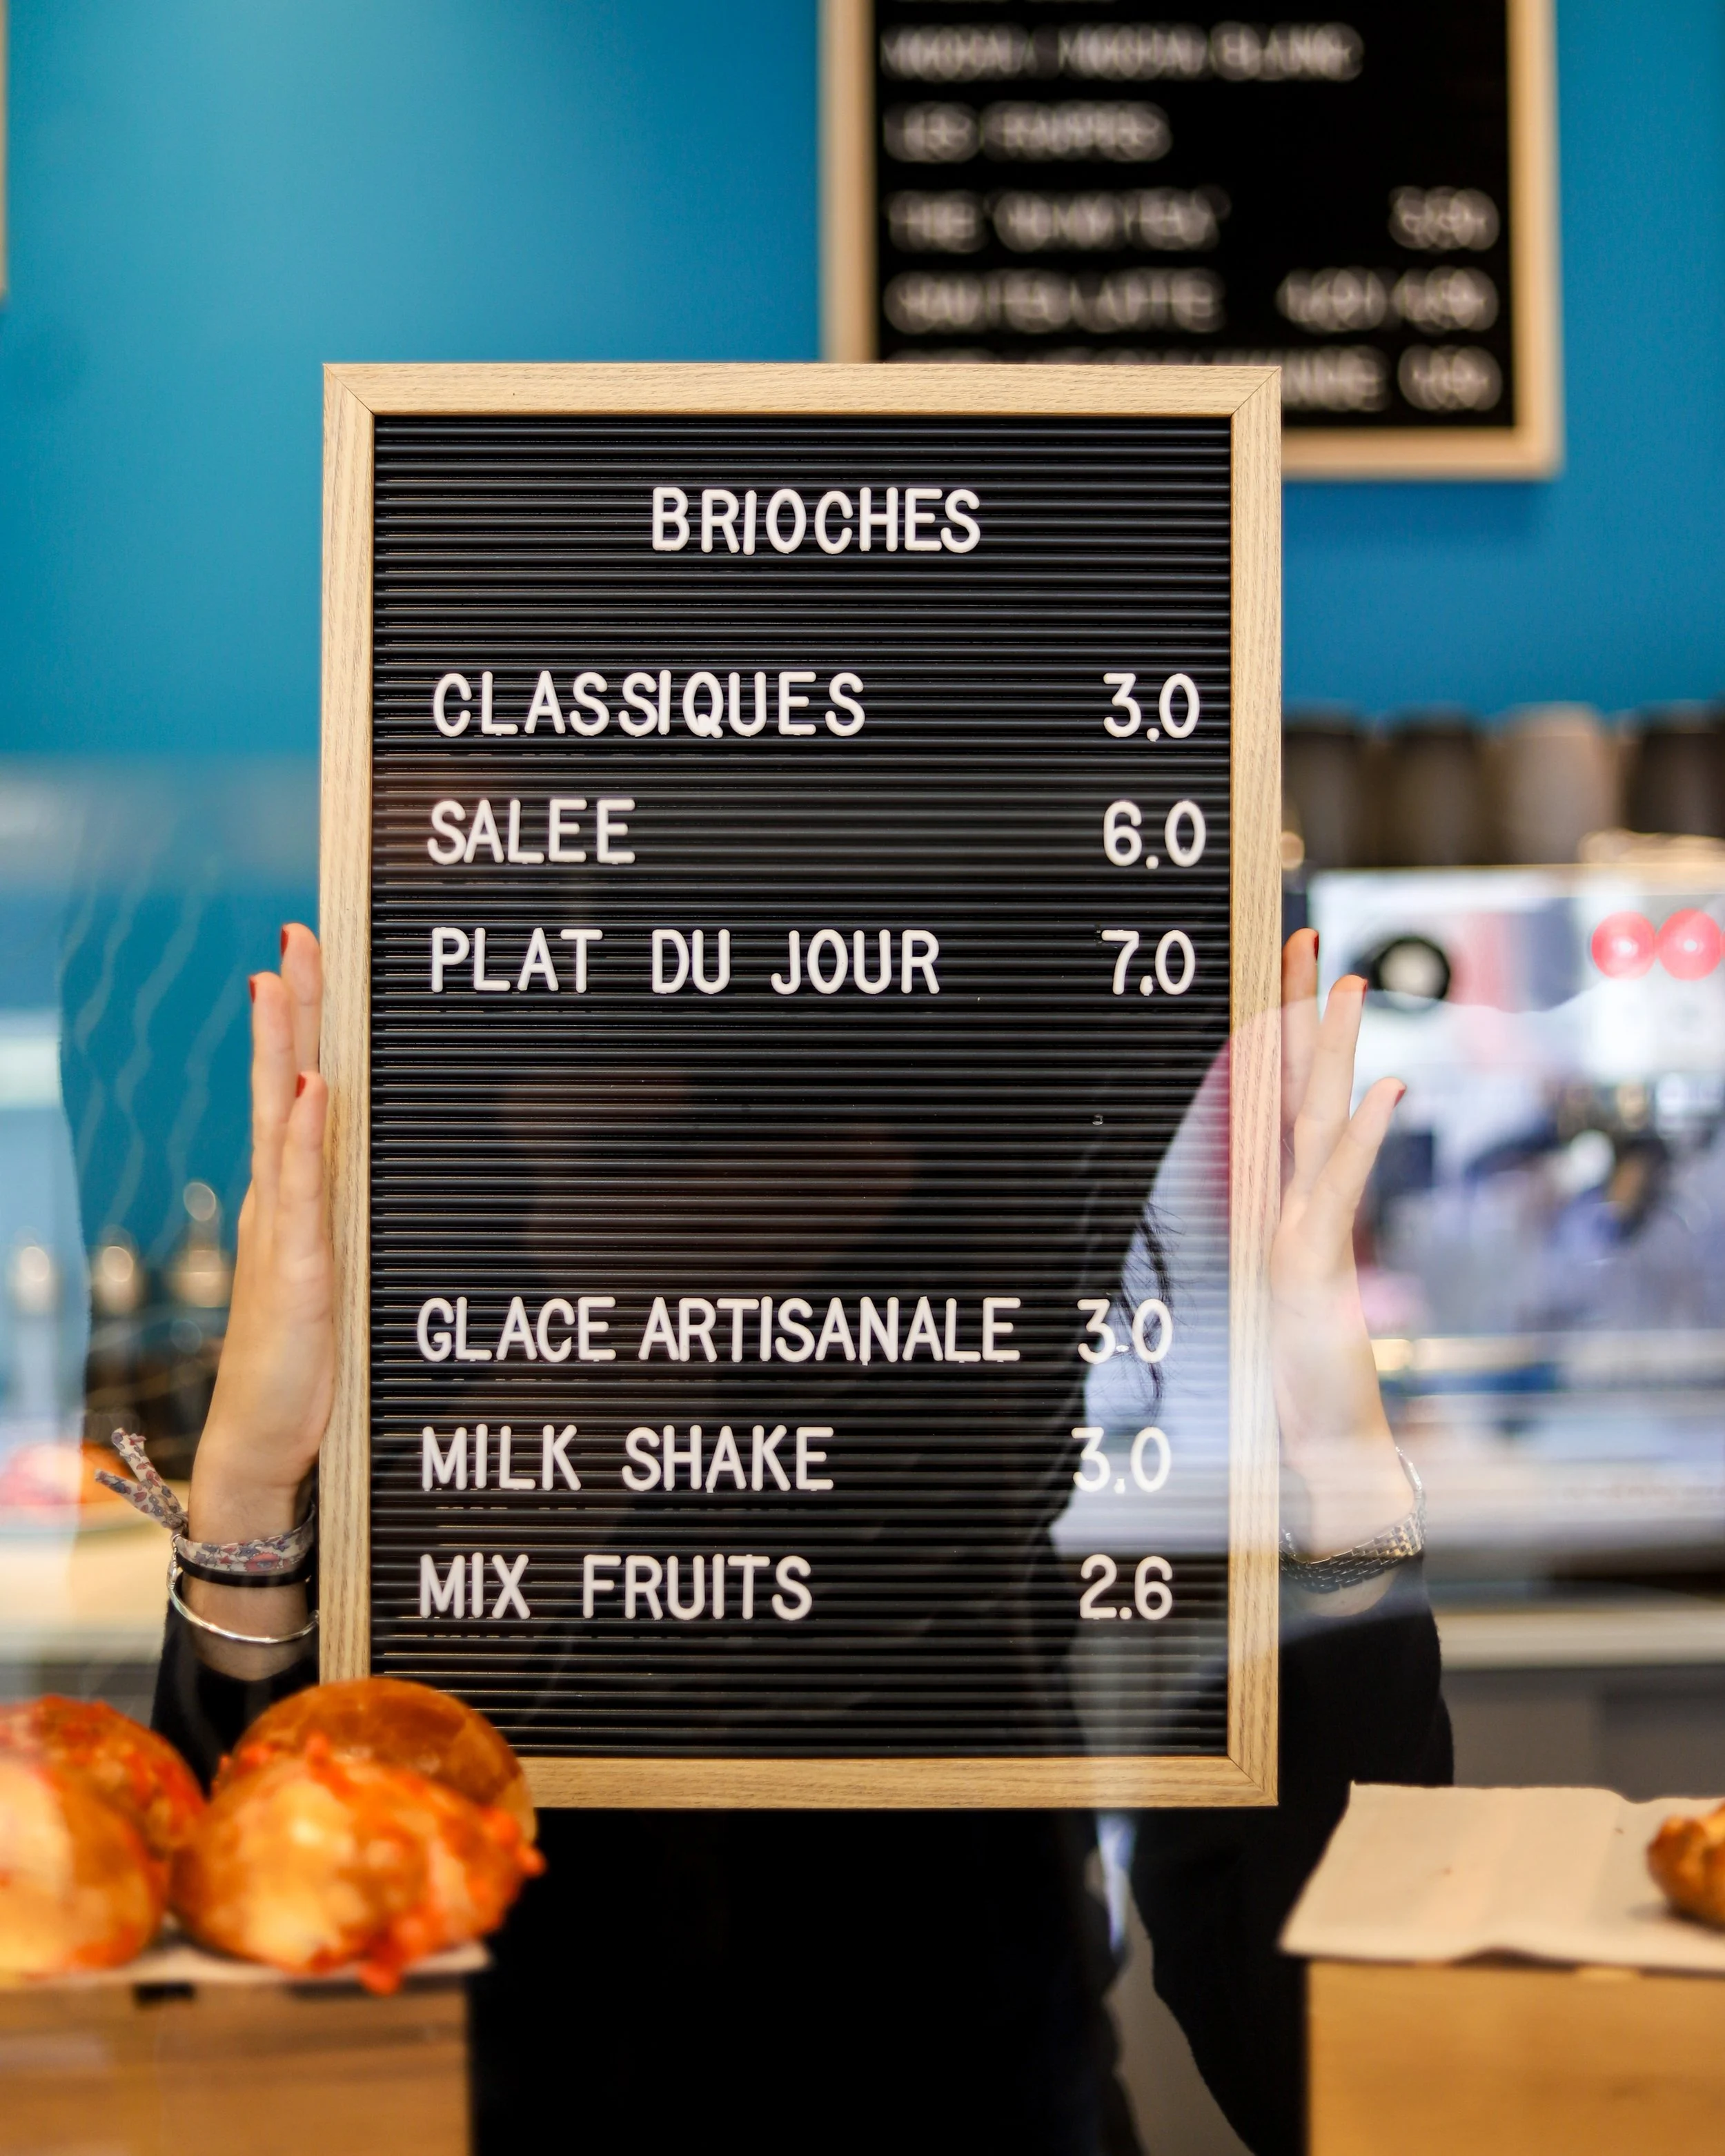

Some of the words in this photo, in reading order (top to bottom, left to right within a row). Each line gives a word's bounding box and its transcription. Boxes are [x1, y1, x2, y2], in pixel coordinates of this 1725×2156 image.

[653, 487, 980, 555] BRIOCHES
[433, 670, 865, 738] CLASSIQUES
[1104, 673, 1200, 742] 3.0
[427, 799, 635, 864] SALEE
[1104, 800, 1206, 869] 6.0
[431, 927, 602, 993] PLAT
[652, 929, 730, 995] DU
[771, 929, 940, 995] JOUR
[1102, 930, 1196, 996] 7.0
[417, 1297, 615, 1363] GLACE
[639, 1296, 1021, 1365] ARTISANALE
[1077, 1298, 1173, 1364] 3.0
[422, 1424, 581, 1491] MILK
[622, 1425, 834, 1492] SHAKE
[1071, 1426, 1171, 1494] 3.0
[420, 1554, 530, 1619] MIX
[583, 1554, 812, 1620] FRUITS
[1081, 1554, 1173, 1620] 2.6
